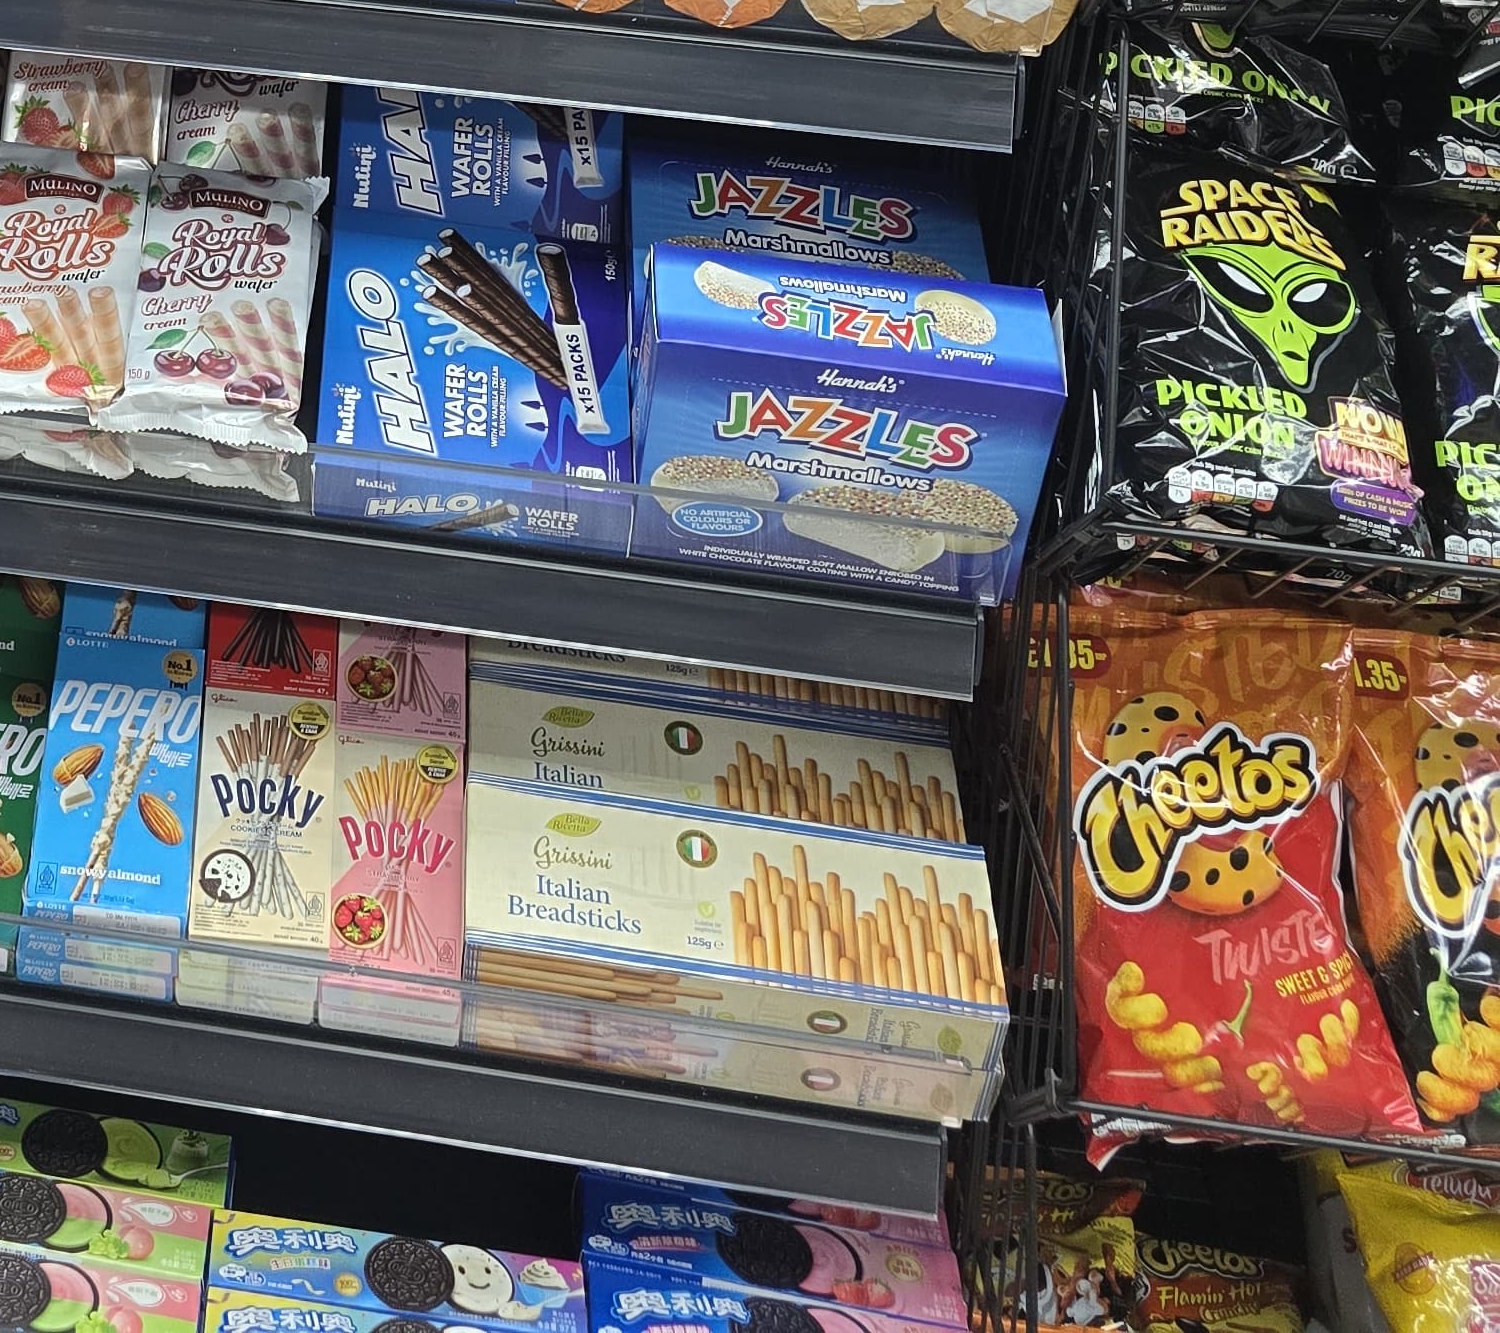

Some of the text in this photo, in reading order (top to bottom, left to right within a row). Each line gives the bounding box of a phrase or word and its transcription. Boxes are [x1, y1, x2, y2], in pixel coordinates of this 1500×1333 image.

[29, 178, 97, 195] MULINO
[1161, 181, 1303, 221] SPACE
[4, 208, 97, 236] Royal
[1162, 209, 1346, 270] RAIDERS
[347, 269, 437, 455] HALO
[817, 368, 899, 395] Hannah's
[444, 362, 466, 439] WAFER
[466, 368, 487, 438] ROLLS
[1156, 379, 1307, 418] PICKLED
[714, 388, 985, 471] JAZZLES
[1180, 407, 1295, 450] ONION
[746, 450, 932, 492] Marshmallows
[167, 654, 194, 670] No.1
[49, 681, 200, 744] PEPERO
[210, 772, 325, 829] Pocky
[340, 814, 456, 873] Pocky
[1078, 744, 1316, 909] Cheetos
[533, 836, 614, 871] Grissini
[536, 874, 612, 906] Italian
[507, 895, 642, 935] Breadsticks
